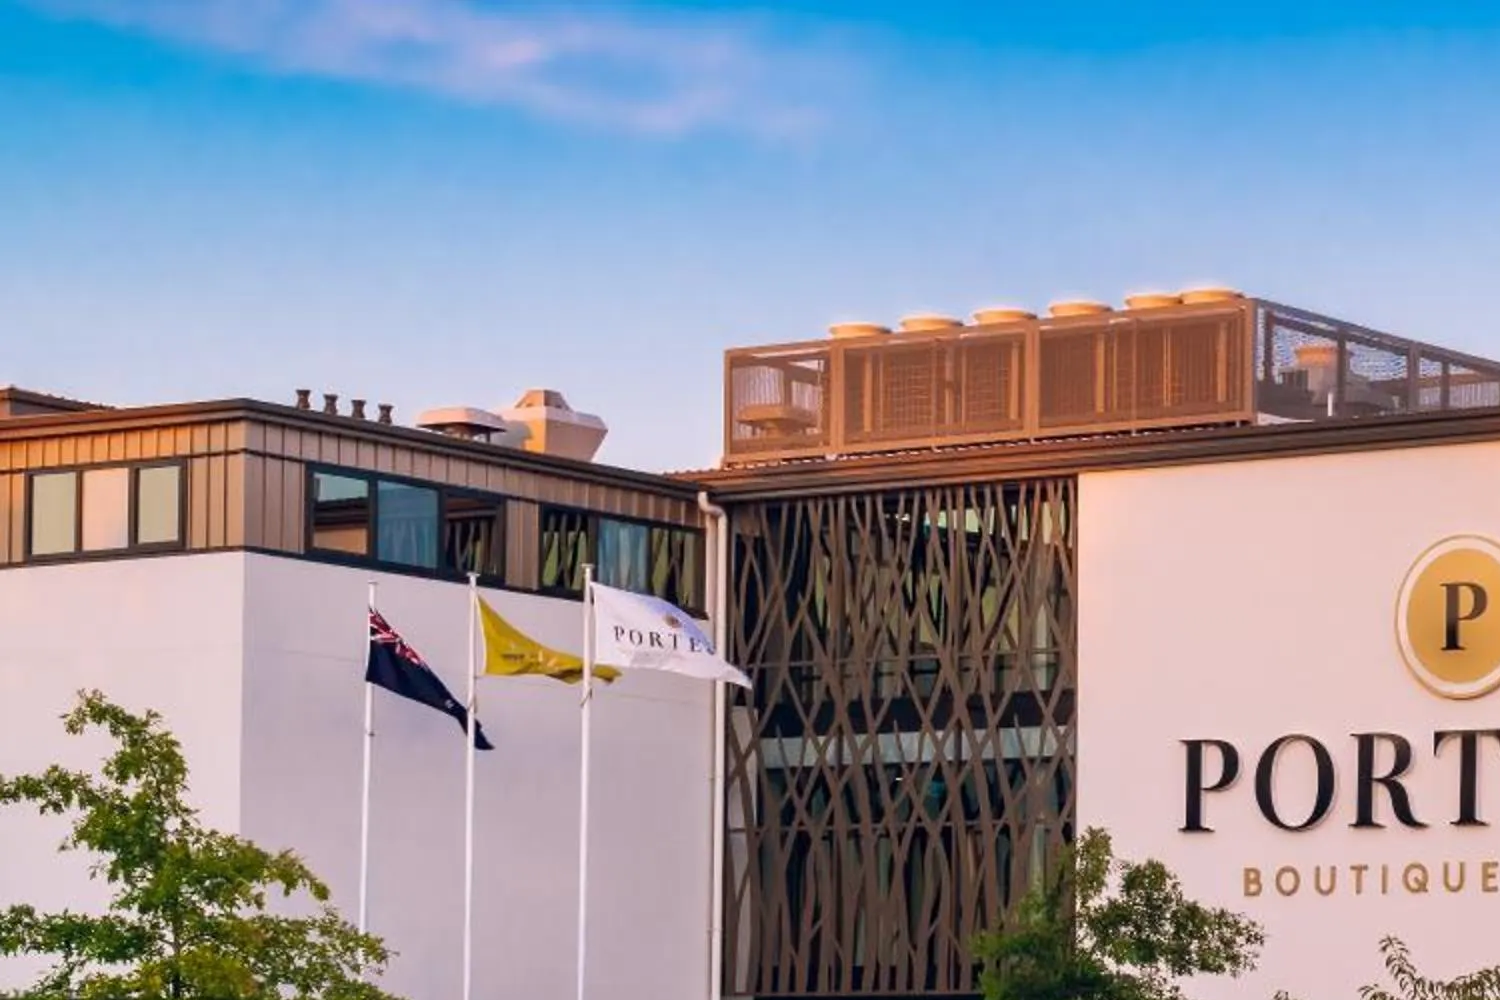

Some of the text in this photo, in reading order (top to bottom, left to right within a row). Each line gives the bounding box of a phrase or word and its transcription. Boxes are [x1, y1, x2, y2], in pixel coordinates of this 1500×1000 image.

[1438, 581, 1488, 651] P
[613, 625, 716, 655] PORTE
[1243, 860, 1500, 897] BOUTIQUE
